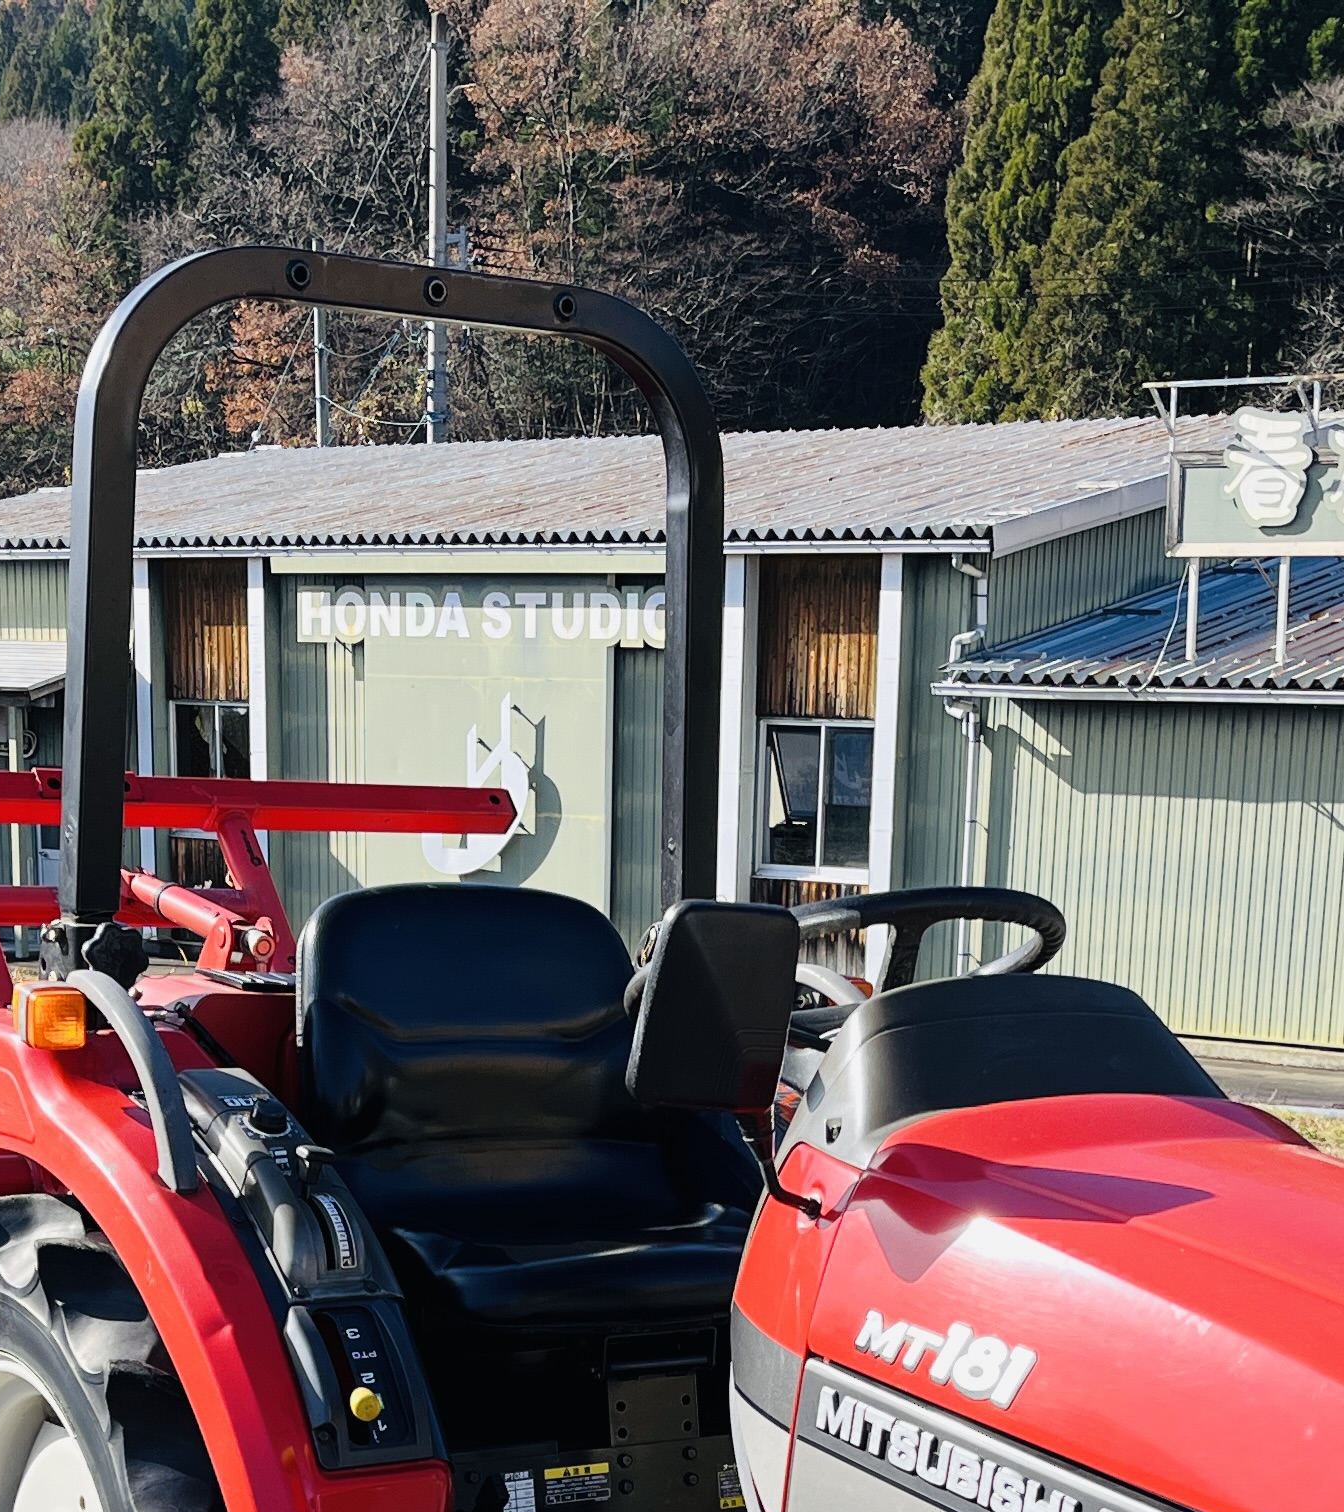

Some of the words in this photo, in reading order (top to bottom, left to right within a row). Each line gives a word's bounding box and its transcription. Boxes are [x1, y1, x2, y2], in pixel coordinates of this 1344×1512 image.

[301, 591, 470, 638] HONDA
[345, 1328, 361, 1340] 3
[351, 1350, 378, 1360] PTO
[854, 1309, 1038, 1411] MT181
[360, 1372, 376, 1384] 2
